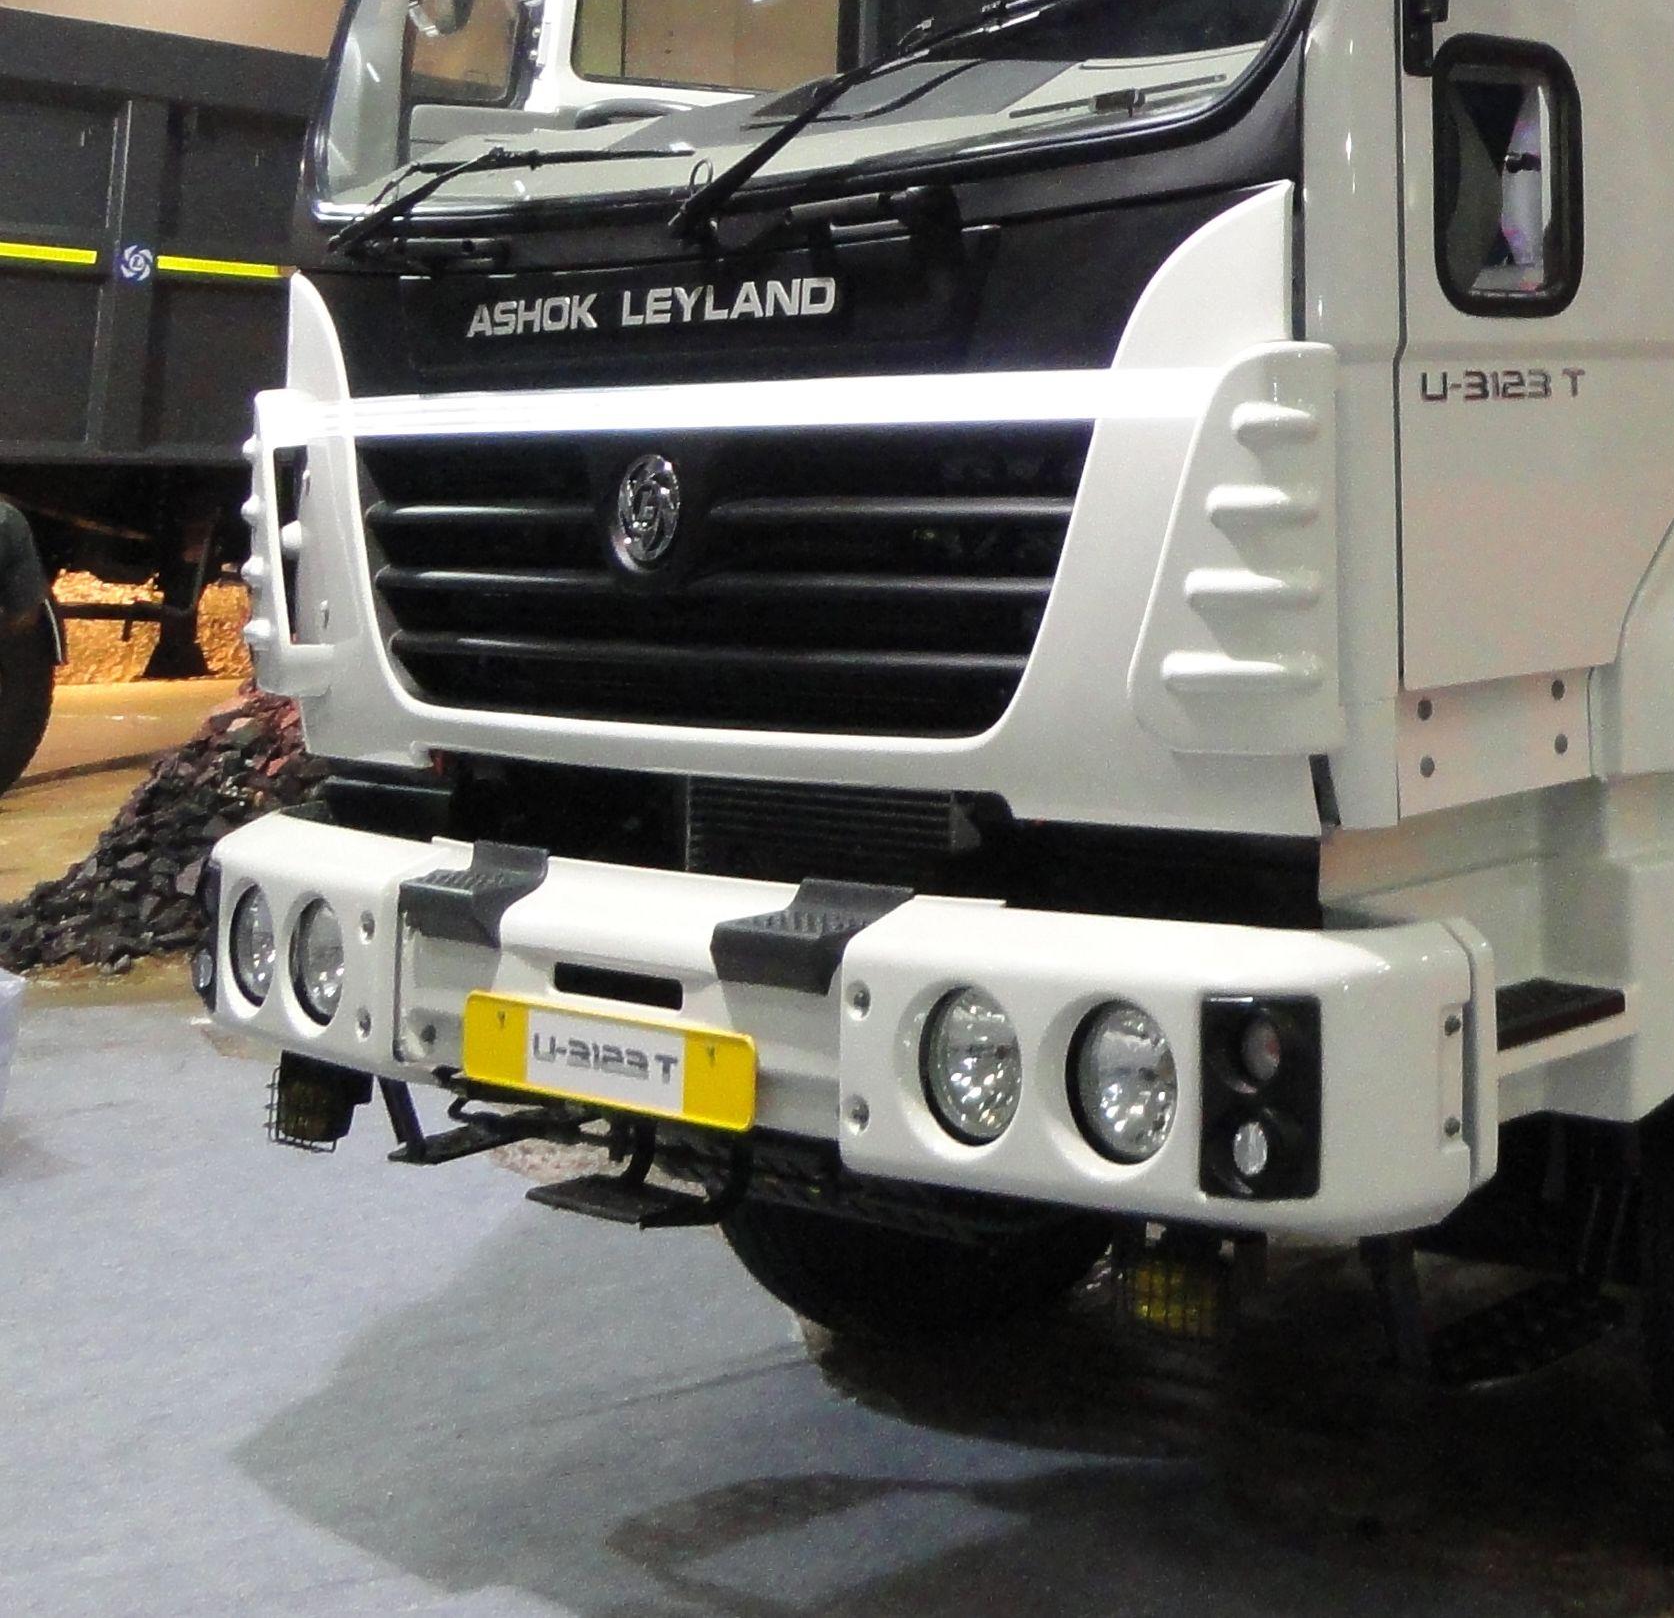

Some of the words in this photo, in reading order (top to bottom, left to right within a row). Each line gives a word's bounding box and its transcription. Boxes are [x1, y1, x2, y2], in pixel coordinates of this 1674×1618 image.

[467, 293, 597, 338] ASHOK
[621, 278, 836, 326] LEYLAND
[1421, 369, 1551, 400] U-3123
[1563, 368, 1585, 397] T
[655, 1053, 678, 1084] T
